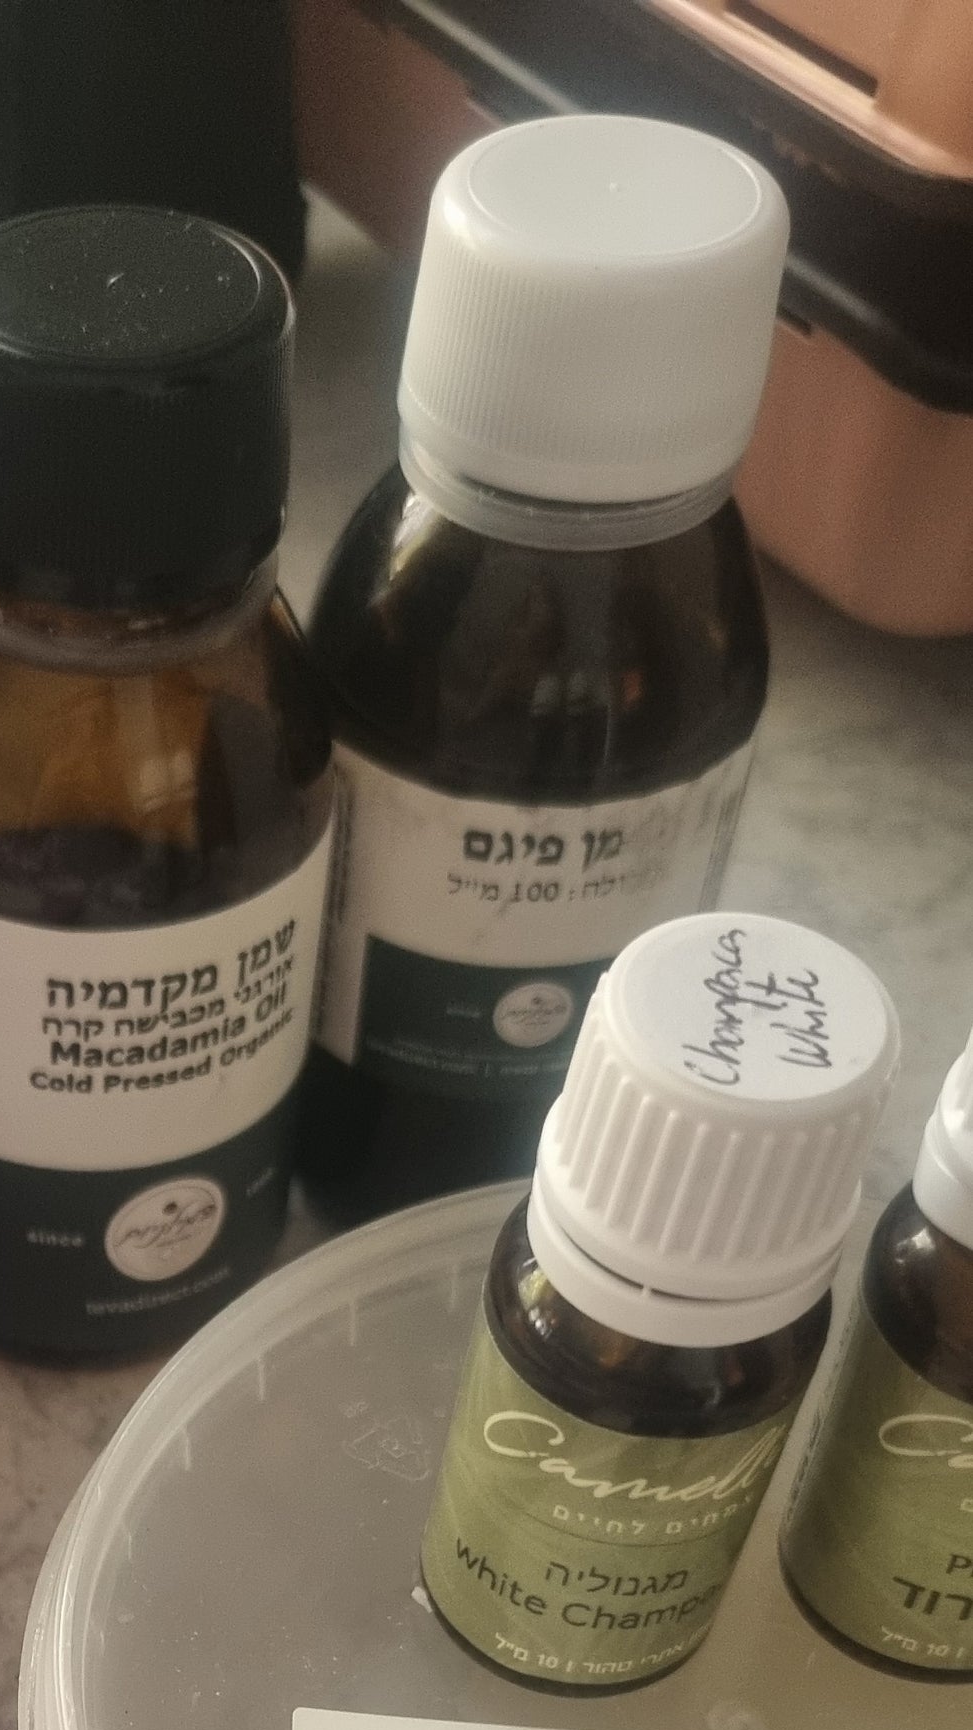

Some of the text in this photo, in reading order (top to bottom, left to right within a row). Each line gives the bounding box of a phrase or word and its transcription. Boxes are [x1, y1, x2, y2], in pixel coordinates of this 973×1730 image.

[463, 829, 565, 867] פיגם
[47, 918, 295, 1013] שמן מקדמיה
[30, 1008, 293, 1094] Cold Pressed Organic
[50, 982, 286, 1068] Macadamia Oil
[455, 1537, 547, 1616] White
[544, 1560, 689, 1597] מגנוליה
[536, 1653, 559, 1669] 10
